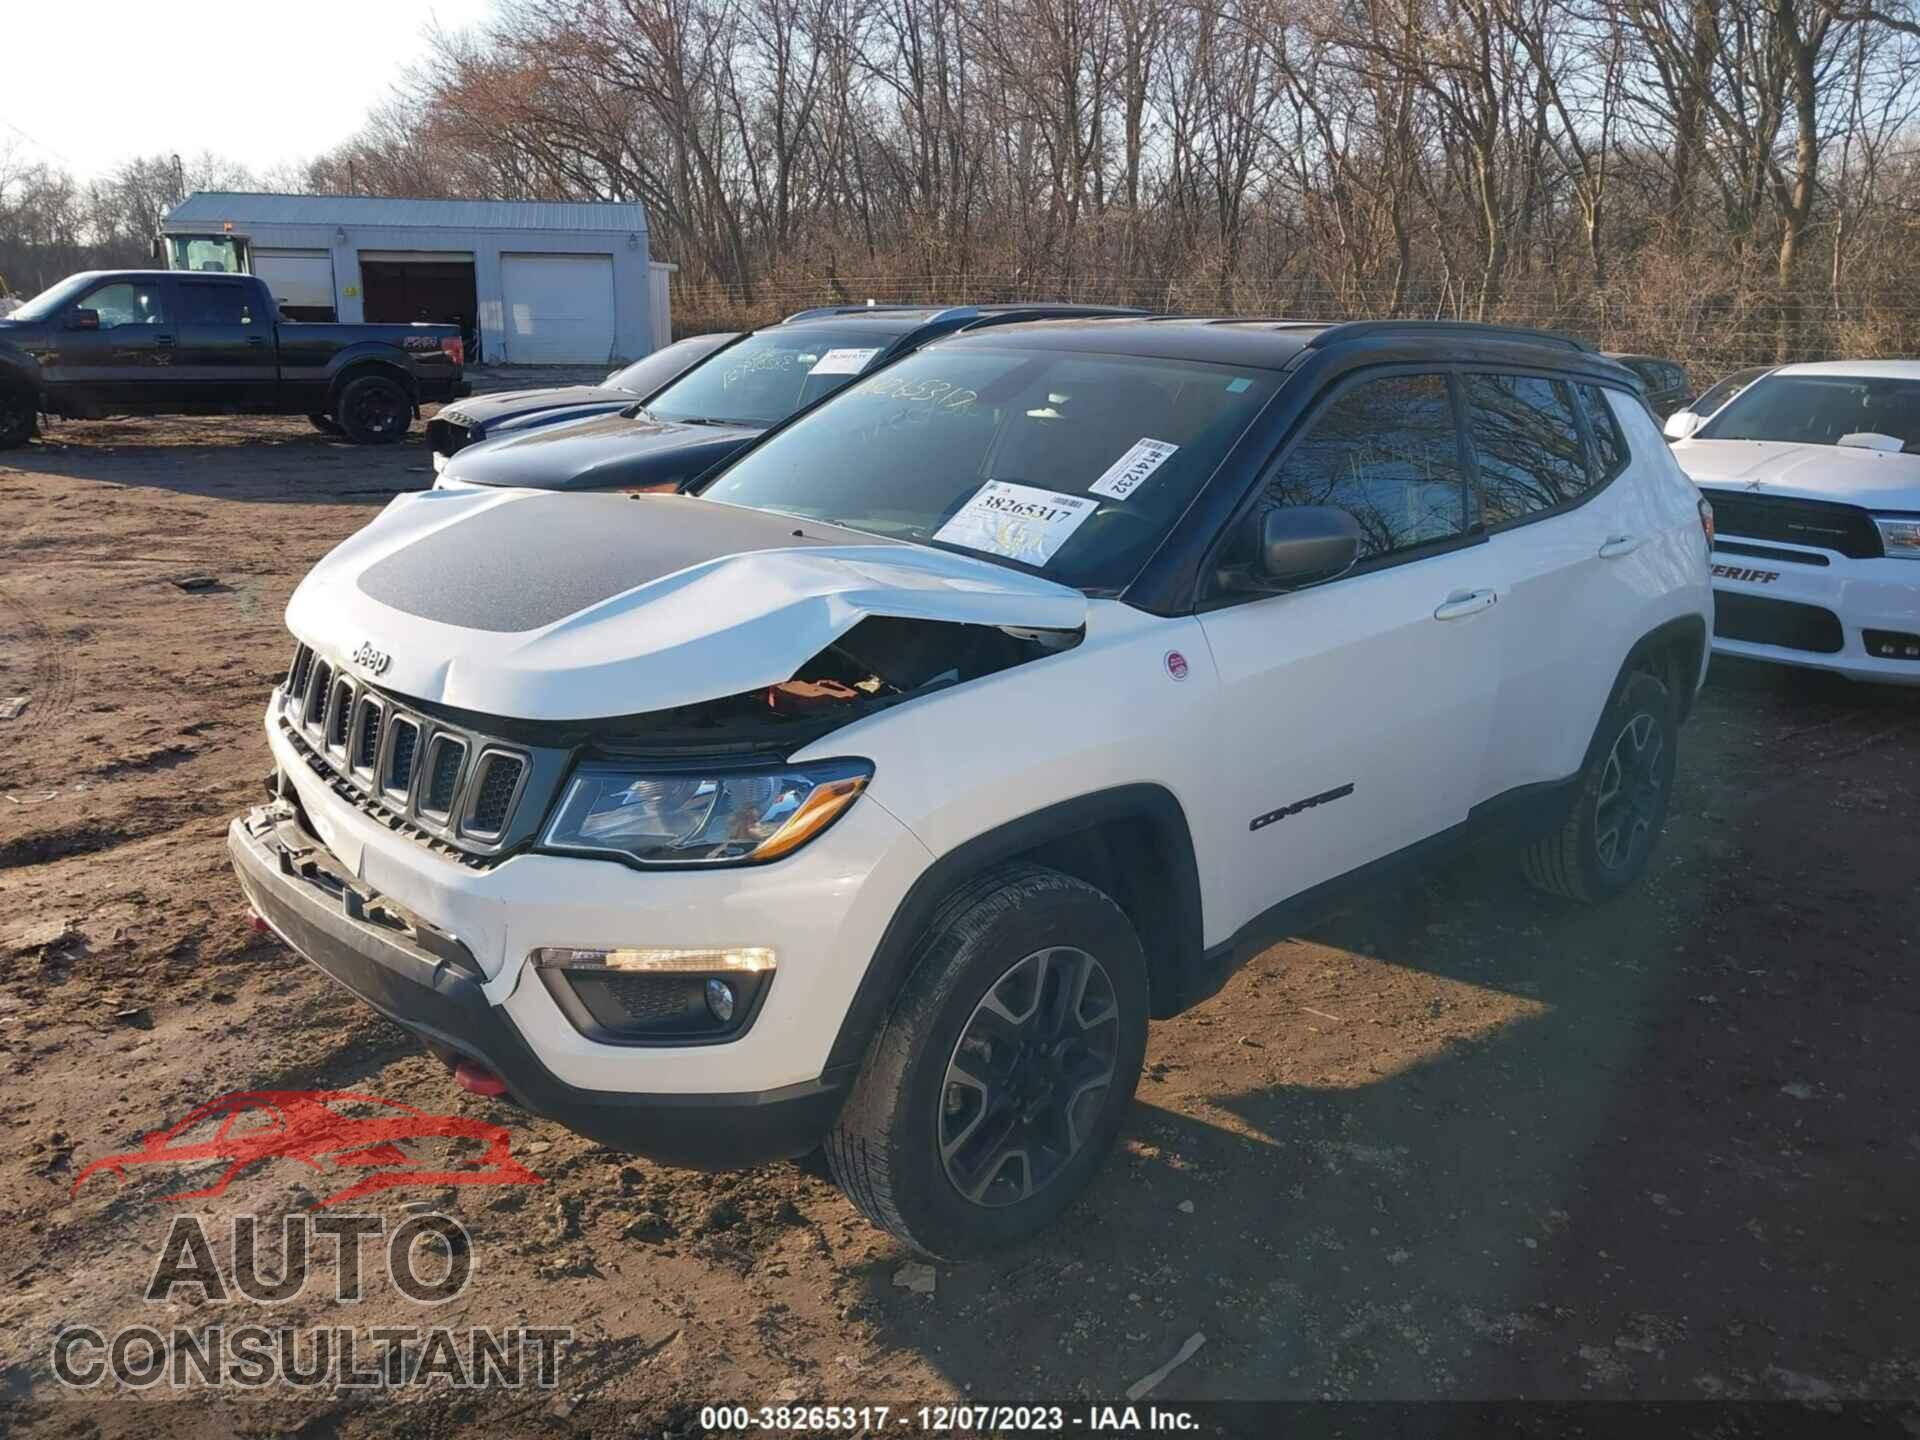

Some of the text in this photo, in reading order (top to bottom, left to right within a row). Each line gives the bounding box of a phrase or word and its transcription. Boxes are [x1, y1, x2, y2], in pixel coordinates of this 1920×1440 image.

[1111, 450, 1163, 494] #141232
[979, 495, 1072, 523] 38265317
[1710, 564, 1780, 583] ERIFF
[352, 641, 391, 677] Jeep
